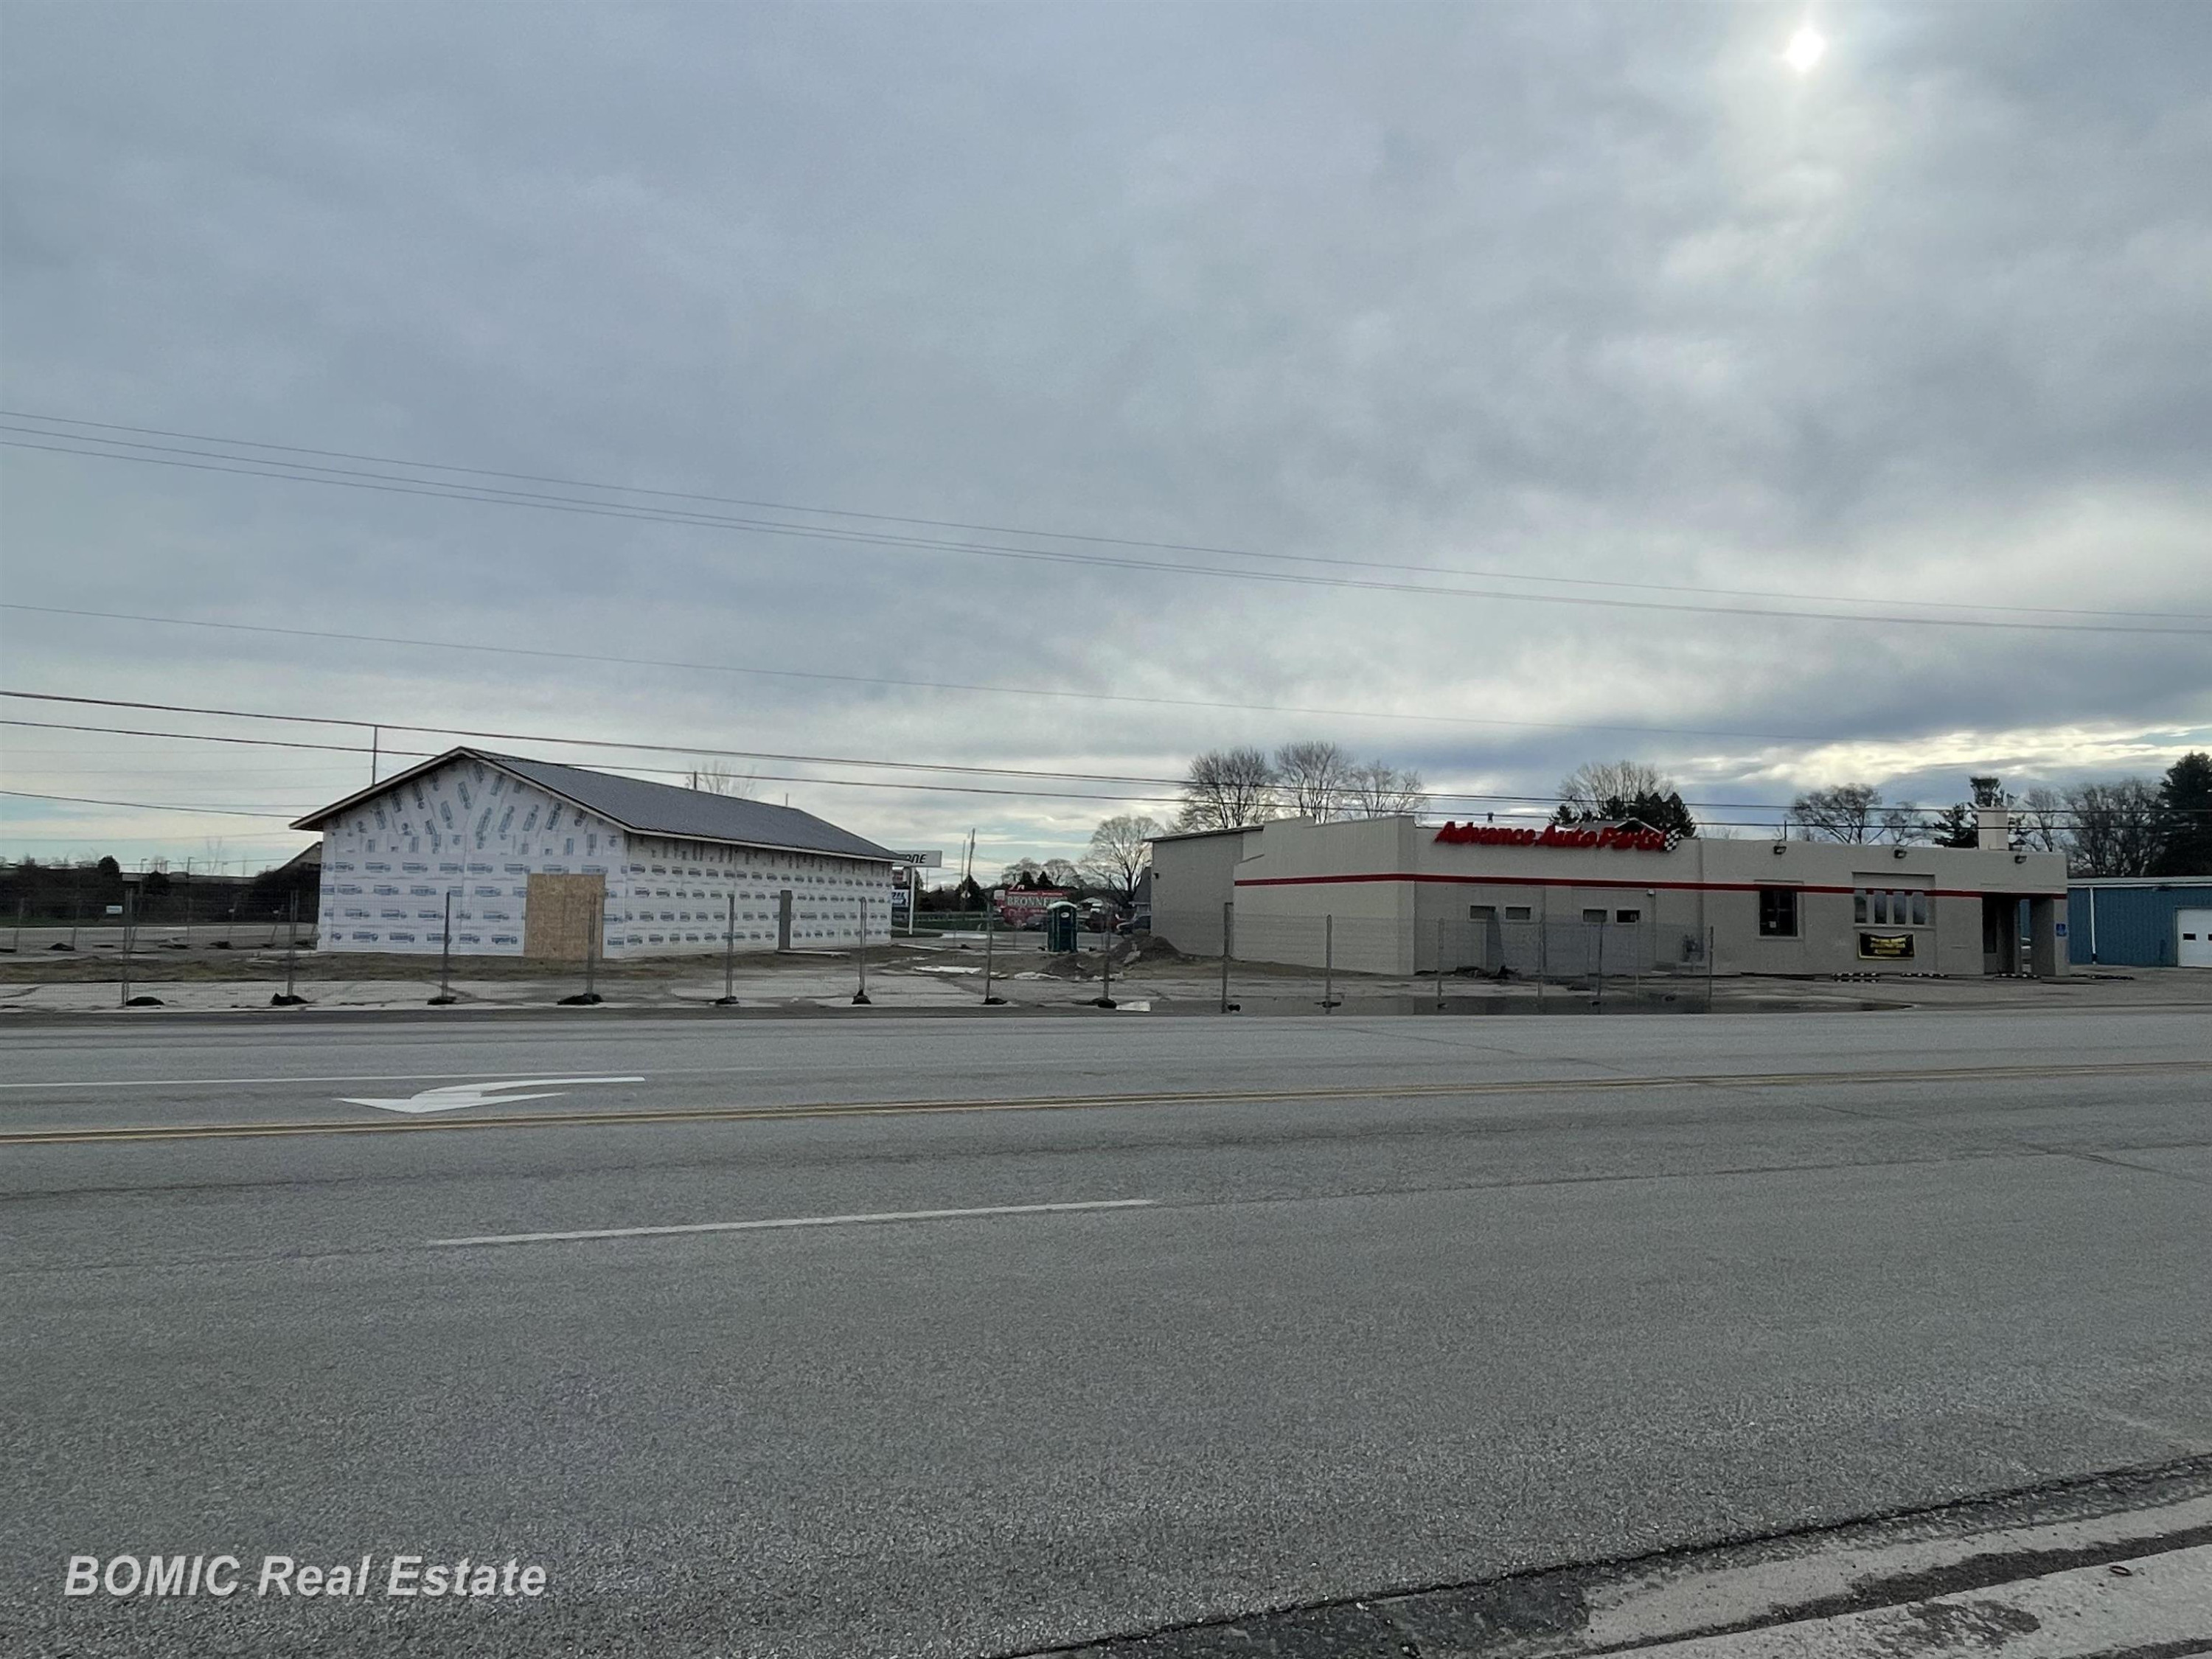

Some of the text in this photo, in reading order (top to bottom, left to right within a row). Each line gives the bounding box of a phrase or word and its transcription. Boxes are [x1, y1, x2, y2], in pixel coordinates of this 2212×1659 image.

[1434, 821, 1537, 846] Advance
[1533, 824, 1597, 848] Auto
[1006, 896, 1068, 908] BRONNE
